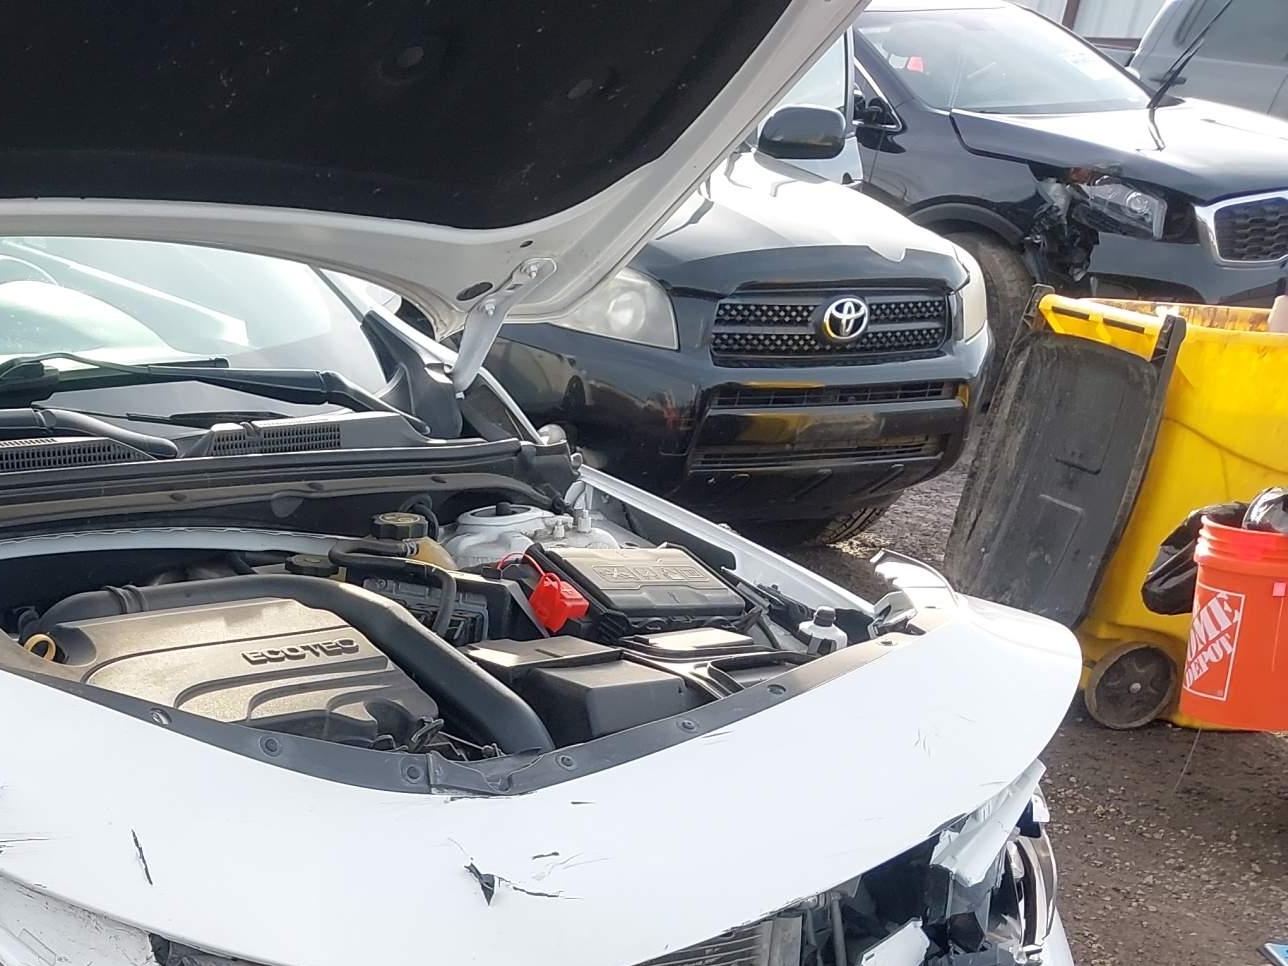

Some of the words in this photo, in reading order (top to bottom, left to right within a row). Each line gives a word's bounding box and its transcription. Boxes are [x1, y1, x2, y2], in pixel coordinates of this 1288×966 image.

[242, 638, 360, 665] ECOTEC
[1187, 591, 1240, 662] OME
[1185, 633, 1233, 688] DEPOT
